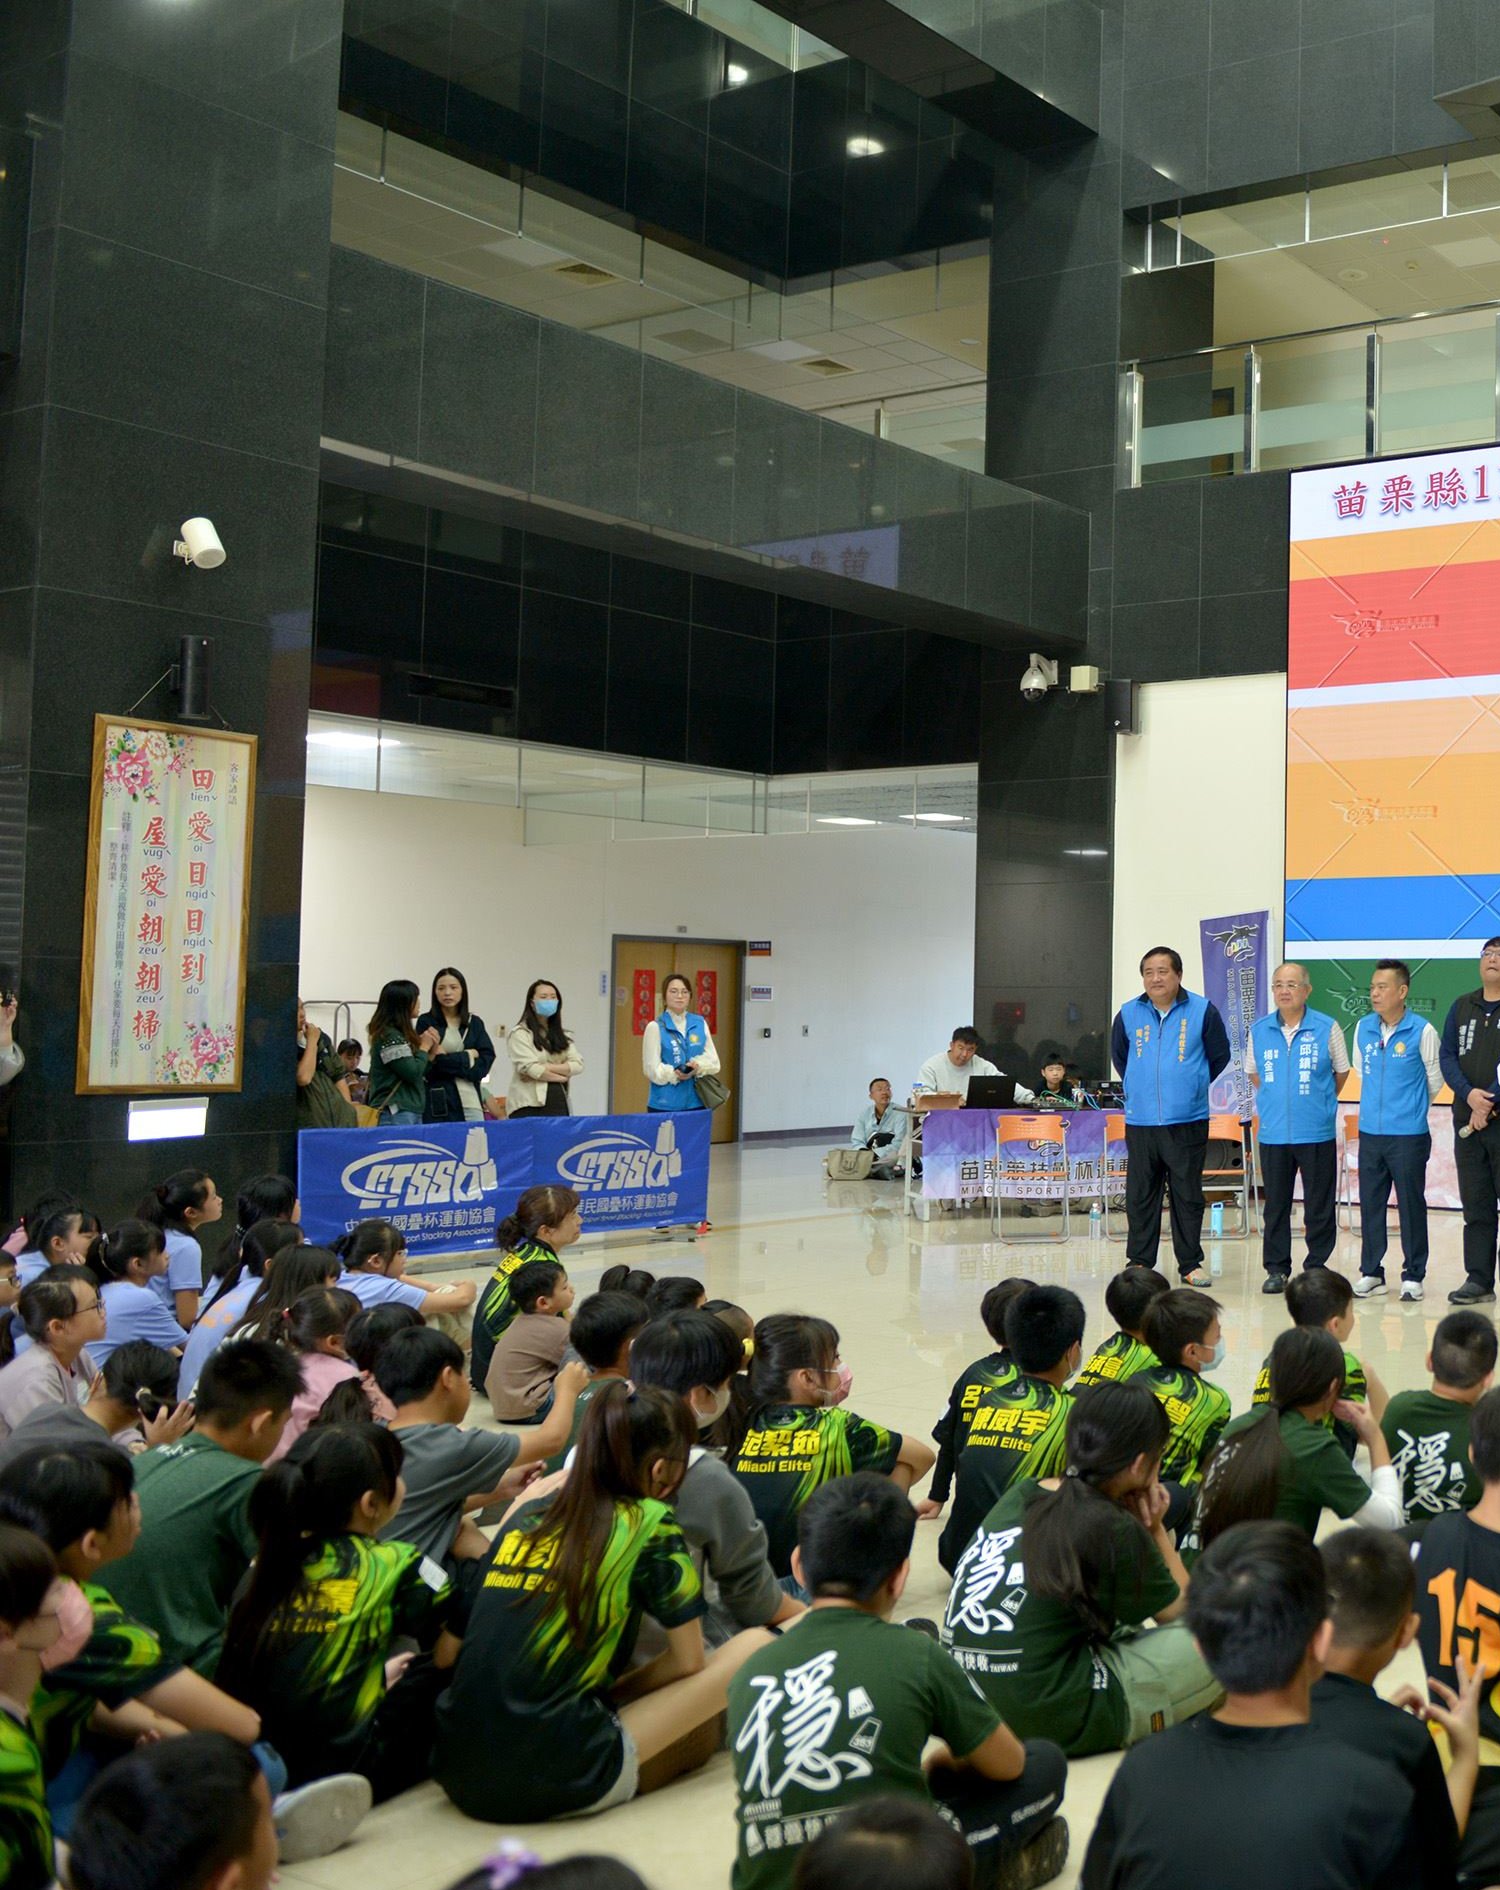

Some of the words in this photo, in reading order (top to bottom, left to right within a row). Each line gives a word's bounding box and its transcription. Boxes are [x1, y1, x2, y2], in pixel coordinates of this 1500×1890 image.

[193, 844, 203, 853] oi
[146, 898, 157, 908] oi
[186, 985, 199, 995] do
[138, 1043, 151, 1051] so
[1016, 1186, 1061, 1196] SPORT
[404, 1232, 421, 1244] port
[453, 1226, 494, 1238] Association
[960, 1384, 993, 1409] 呂
[1000, 1437, 1033, 1452] Elite
[736, 1459, 777, 1473] Miaoli
[778, 1459, 813, 1472] Elite
